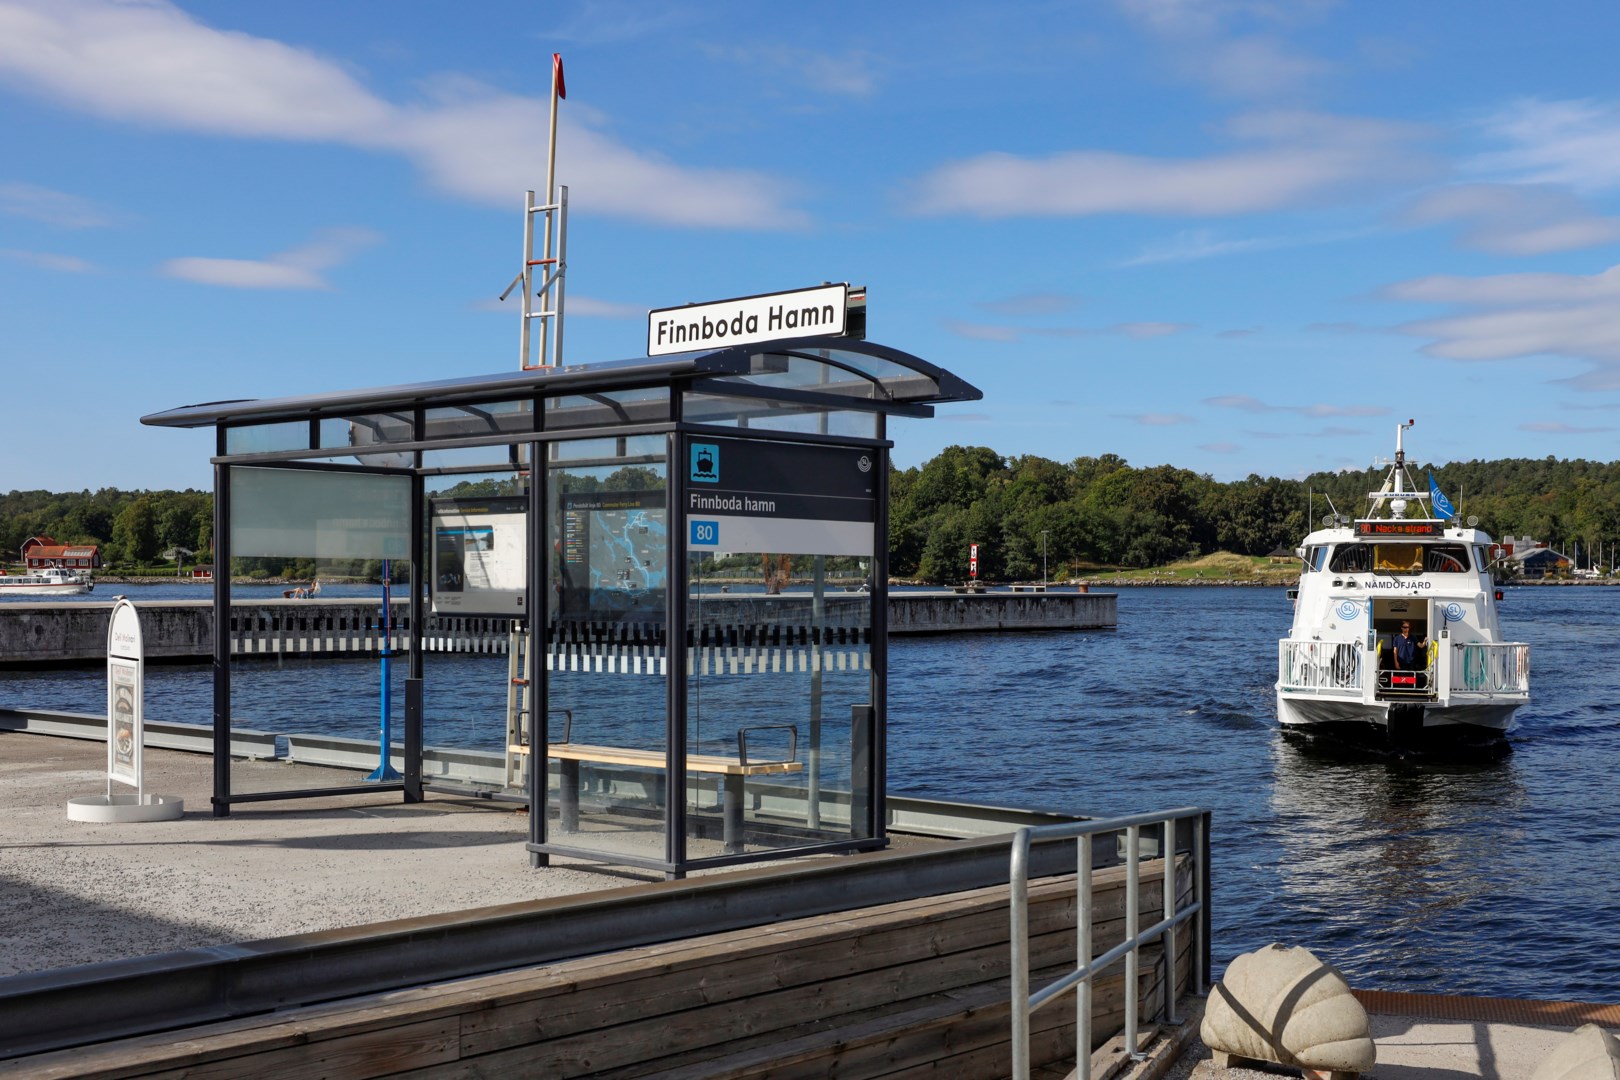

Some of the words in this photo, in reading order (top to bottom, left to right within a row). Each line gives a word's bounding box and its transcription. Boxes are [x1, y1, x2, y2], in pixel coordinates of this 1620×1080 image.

[657, 310, 758, 346] Finnboda
[768, 304, 834, 331] Hamn
[690, 493, 742, 511] Finnboda
[745, 496, 776, 512] hamn
[696, 525, 713, 541] 80
[1375, 524, 1402, 533] Nacka
[1405, 525, 1433, 533] strand
